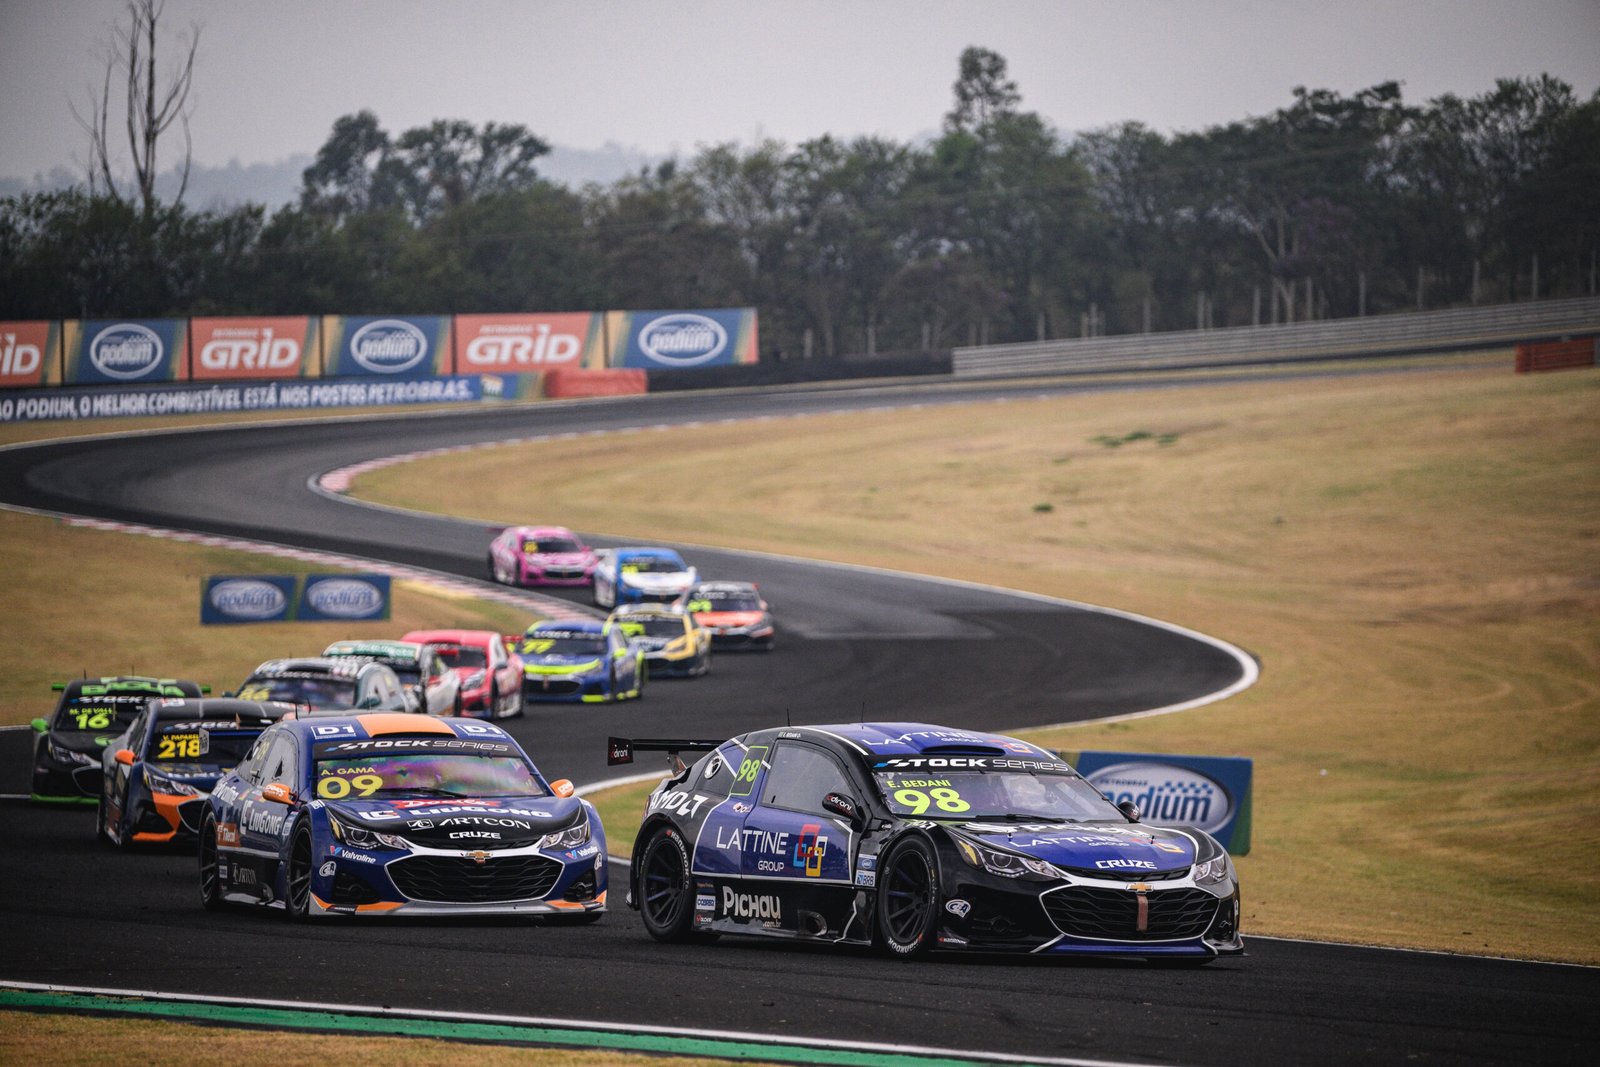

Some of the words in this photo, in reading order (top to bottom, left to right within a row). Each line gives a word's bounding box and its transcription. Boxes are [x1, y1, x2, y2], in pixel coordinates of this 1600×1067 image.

[200, 328, 299, 369] GRID
[467, 324, 580, 364] GRID
[0, 332, 40, 376] ID
[99, 341, 153, 366] podium
[80, 396, 92, 418] O
[92, 392, 148, 416] MELHOR
[148, 384, 241, 414] COMBUSTÍVEL
[243, 382, 278, 408] ESTÁ
[281, 386, 310, 407] NOS
[310, 384, 367, 406] POSTOS
[79, 696, 143, 704] STOCK
[76, 712, 110, 729] 16
[338, 740, 430, 750] STOCK
[432, 741, 509, 752] SERIES
[863, 731, 978, 746] LATTINE
[158, 740, 200, 759] 218
[337, 766, 376, 775] GAMA
[737, 760, 760, 781] 98
[887, 758, 988, 768] STOCK
[992, 758, 1069, 772] SERIES
[317, 775, 384, 799] 09
[901, 779, 952, 789] BEDANI
[893, 788, 971, 815] 98
[409, 805, 553, 818] LIUGONG
[439, 817, 531, 830] ARTCON
[449, 832, 502, 840] CRUZE
[716, 826, 788, 855] LATTINE
[342, 850, 376, 864] Valvoline
[1095, 860, 1157, 869] CRUZE
[758, 861, 785, 872] GROUP
[722, 885, 781, 919] PICHAU
